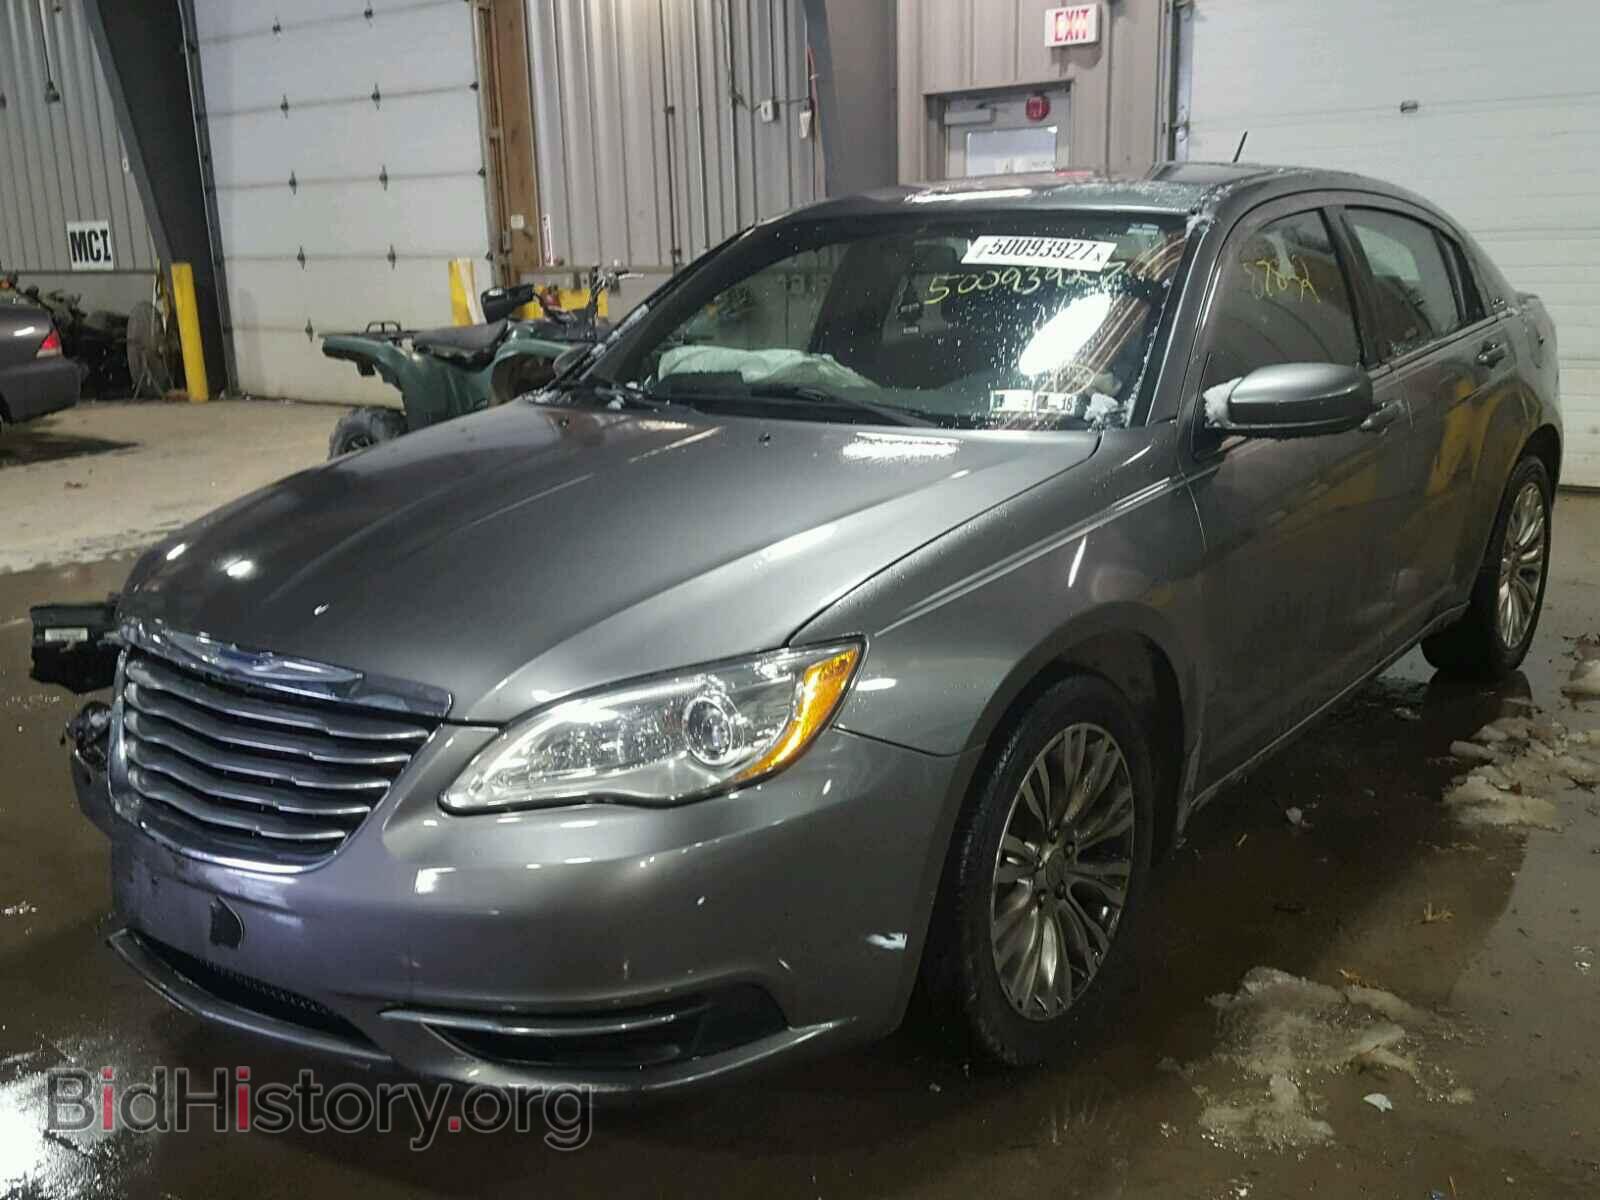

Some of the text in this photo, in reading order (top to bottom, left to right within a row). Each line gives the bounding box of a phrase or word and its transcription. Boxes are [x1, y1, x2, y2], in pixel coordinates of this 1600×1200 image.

[1055, 8, 1089, 42] EXIT
[70, 229, 111, 262] MCI
[986, 238, 1095, 260] 50093927
